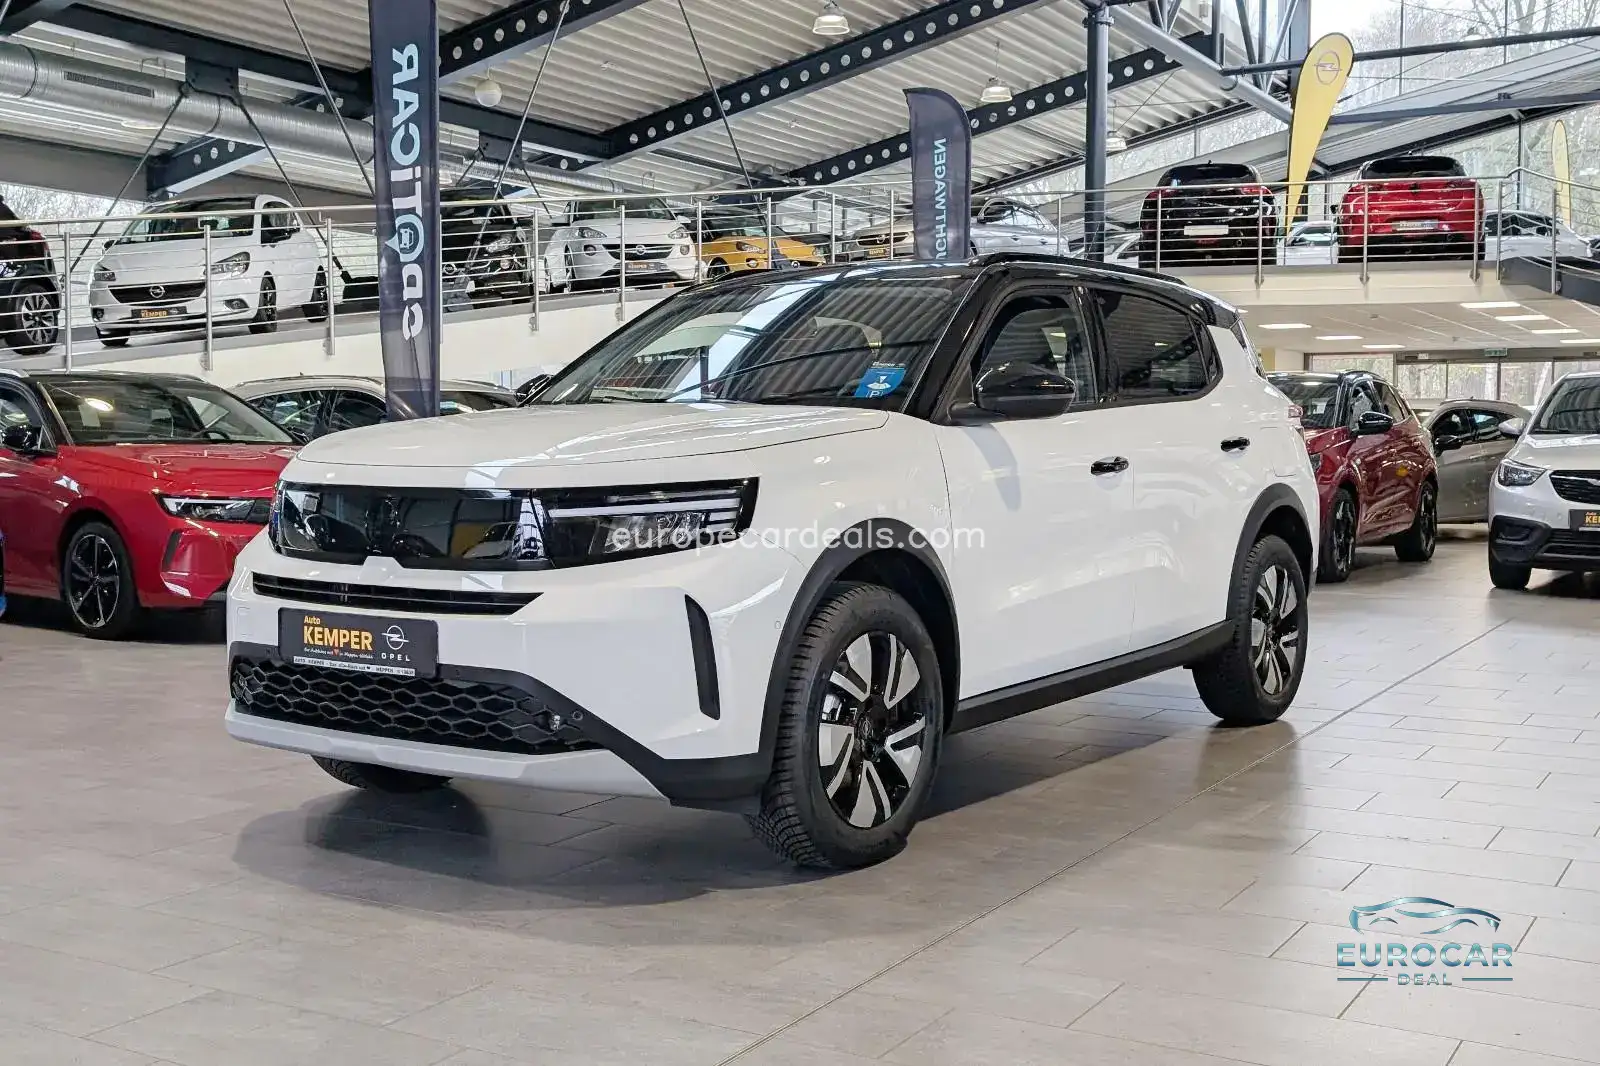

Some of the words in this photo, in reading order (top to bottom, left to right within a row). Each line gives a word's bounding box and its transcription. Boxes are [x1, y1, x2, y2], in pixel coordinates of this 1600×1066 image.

[304, 615, 320, 625] Auto
[303, 625, 373, 651] KEMPER
[381, 652, 411, 662] OPEL
